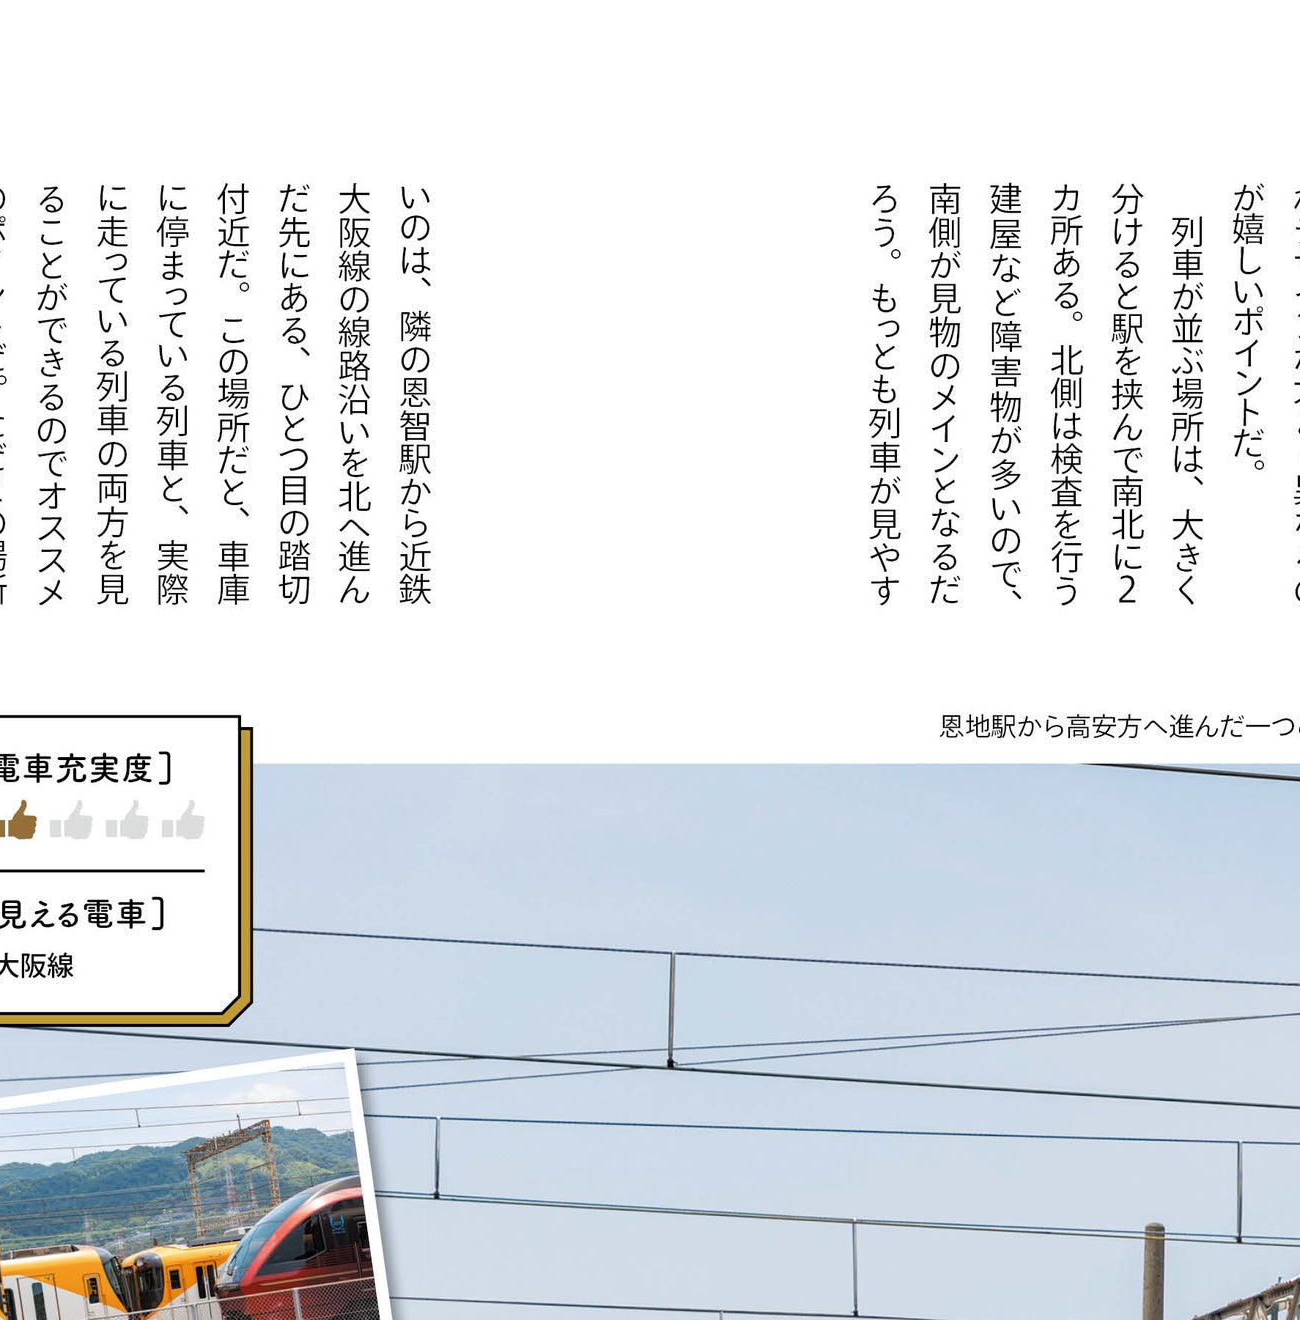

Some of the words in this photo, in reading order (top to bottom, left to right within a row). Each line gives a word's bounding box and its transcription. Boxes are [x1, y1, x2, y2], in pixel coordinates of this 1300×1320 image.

[38, 187, 67, 605] ることができるのでオススメ
[97, 185, 128, 604] に走っている列車の両方を見
[157, 185, 188, 605] に停まっている列車と、実際
[218, 183, 249, 605] 付近だ。この場所だと、車庫
[279, 184, 310, 604] だ先にある、ひとつ目の踏切
[339, 183, 371, 603] 大阪線の線路沿いを北へ進ん
[400, 187, 431, 604] いのは、隣の恩智駅から近鉄
[869, 185, 901, 605] ろう。もっとも列車が見やす
[929, 183, 961, 603] 南側が見物のメインとなるだ
[990, 183, 1022, 599] 建屋など障害物が多いので、
[1051, 184, 1083, 605] カ所ある。北側は検査を行う
[1112, 184, 1144, 603] 分けると駅を挟んで南北に2
[1172, 216, 1203, 604] 列車が並ぶ場所は、大きく
[1233, 184, 1264, 470] が嬉しいポイントだ。
